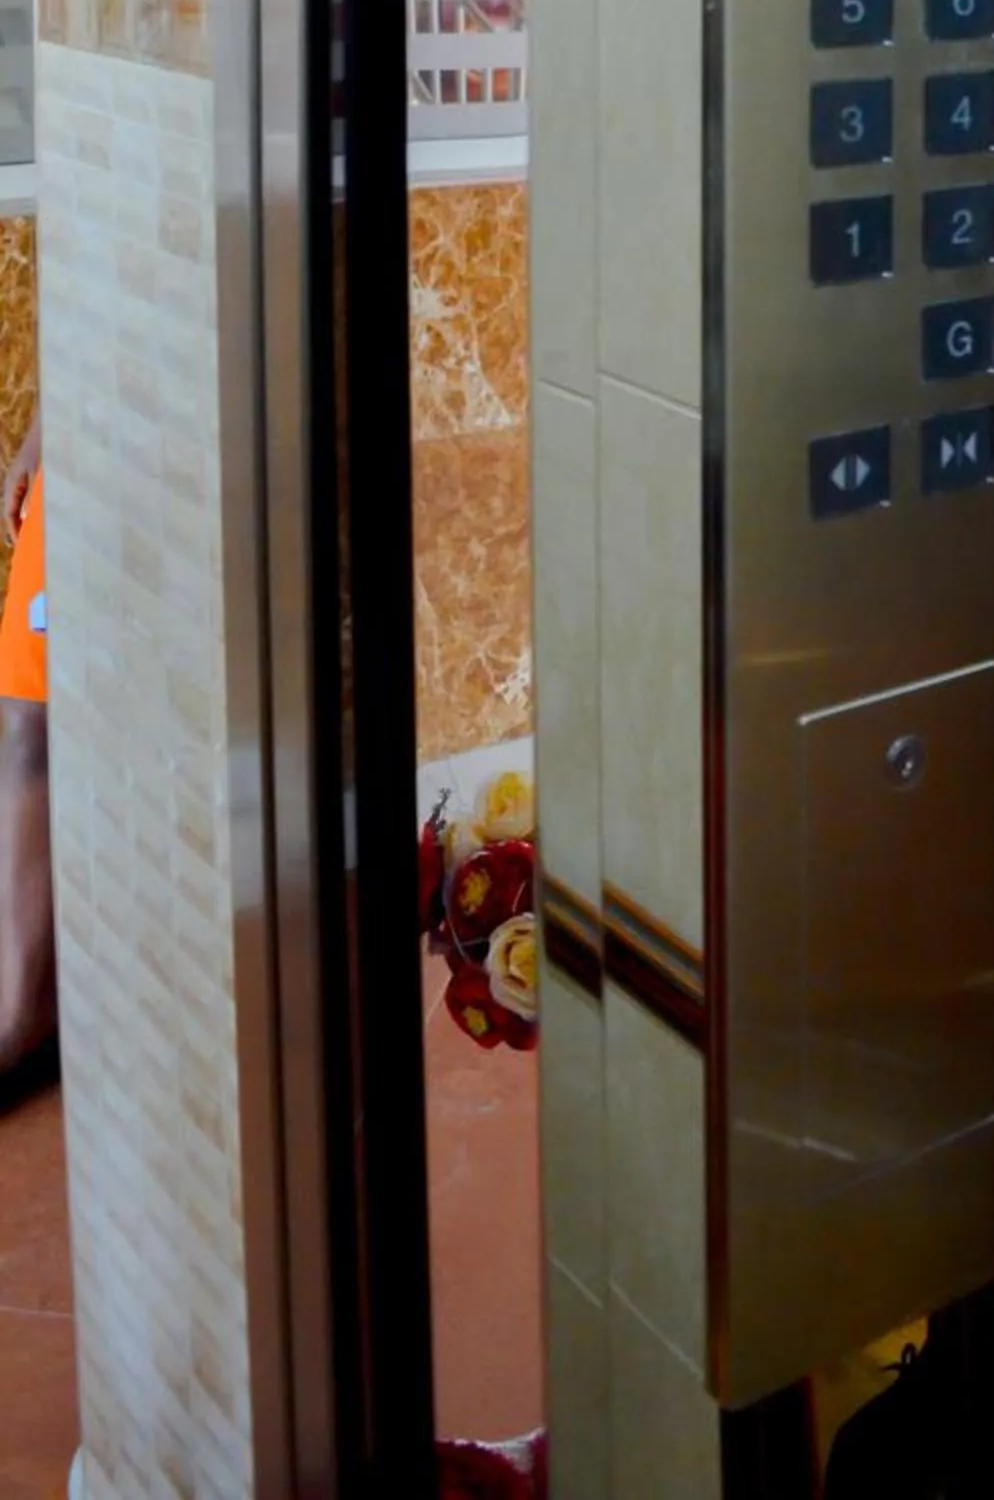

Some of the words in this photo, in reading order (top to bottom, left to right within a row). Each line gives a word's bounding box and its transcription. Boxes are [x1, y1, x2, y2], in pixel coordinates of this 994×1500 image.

[839, 105, 864, 143] 3
[950, 96, 972, 131] 4
[846, 222, 860, 258] 1
[951, 209, 973, 245] 2
[946, 320, 974, 358] G
